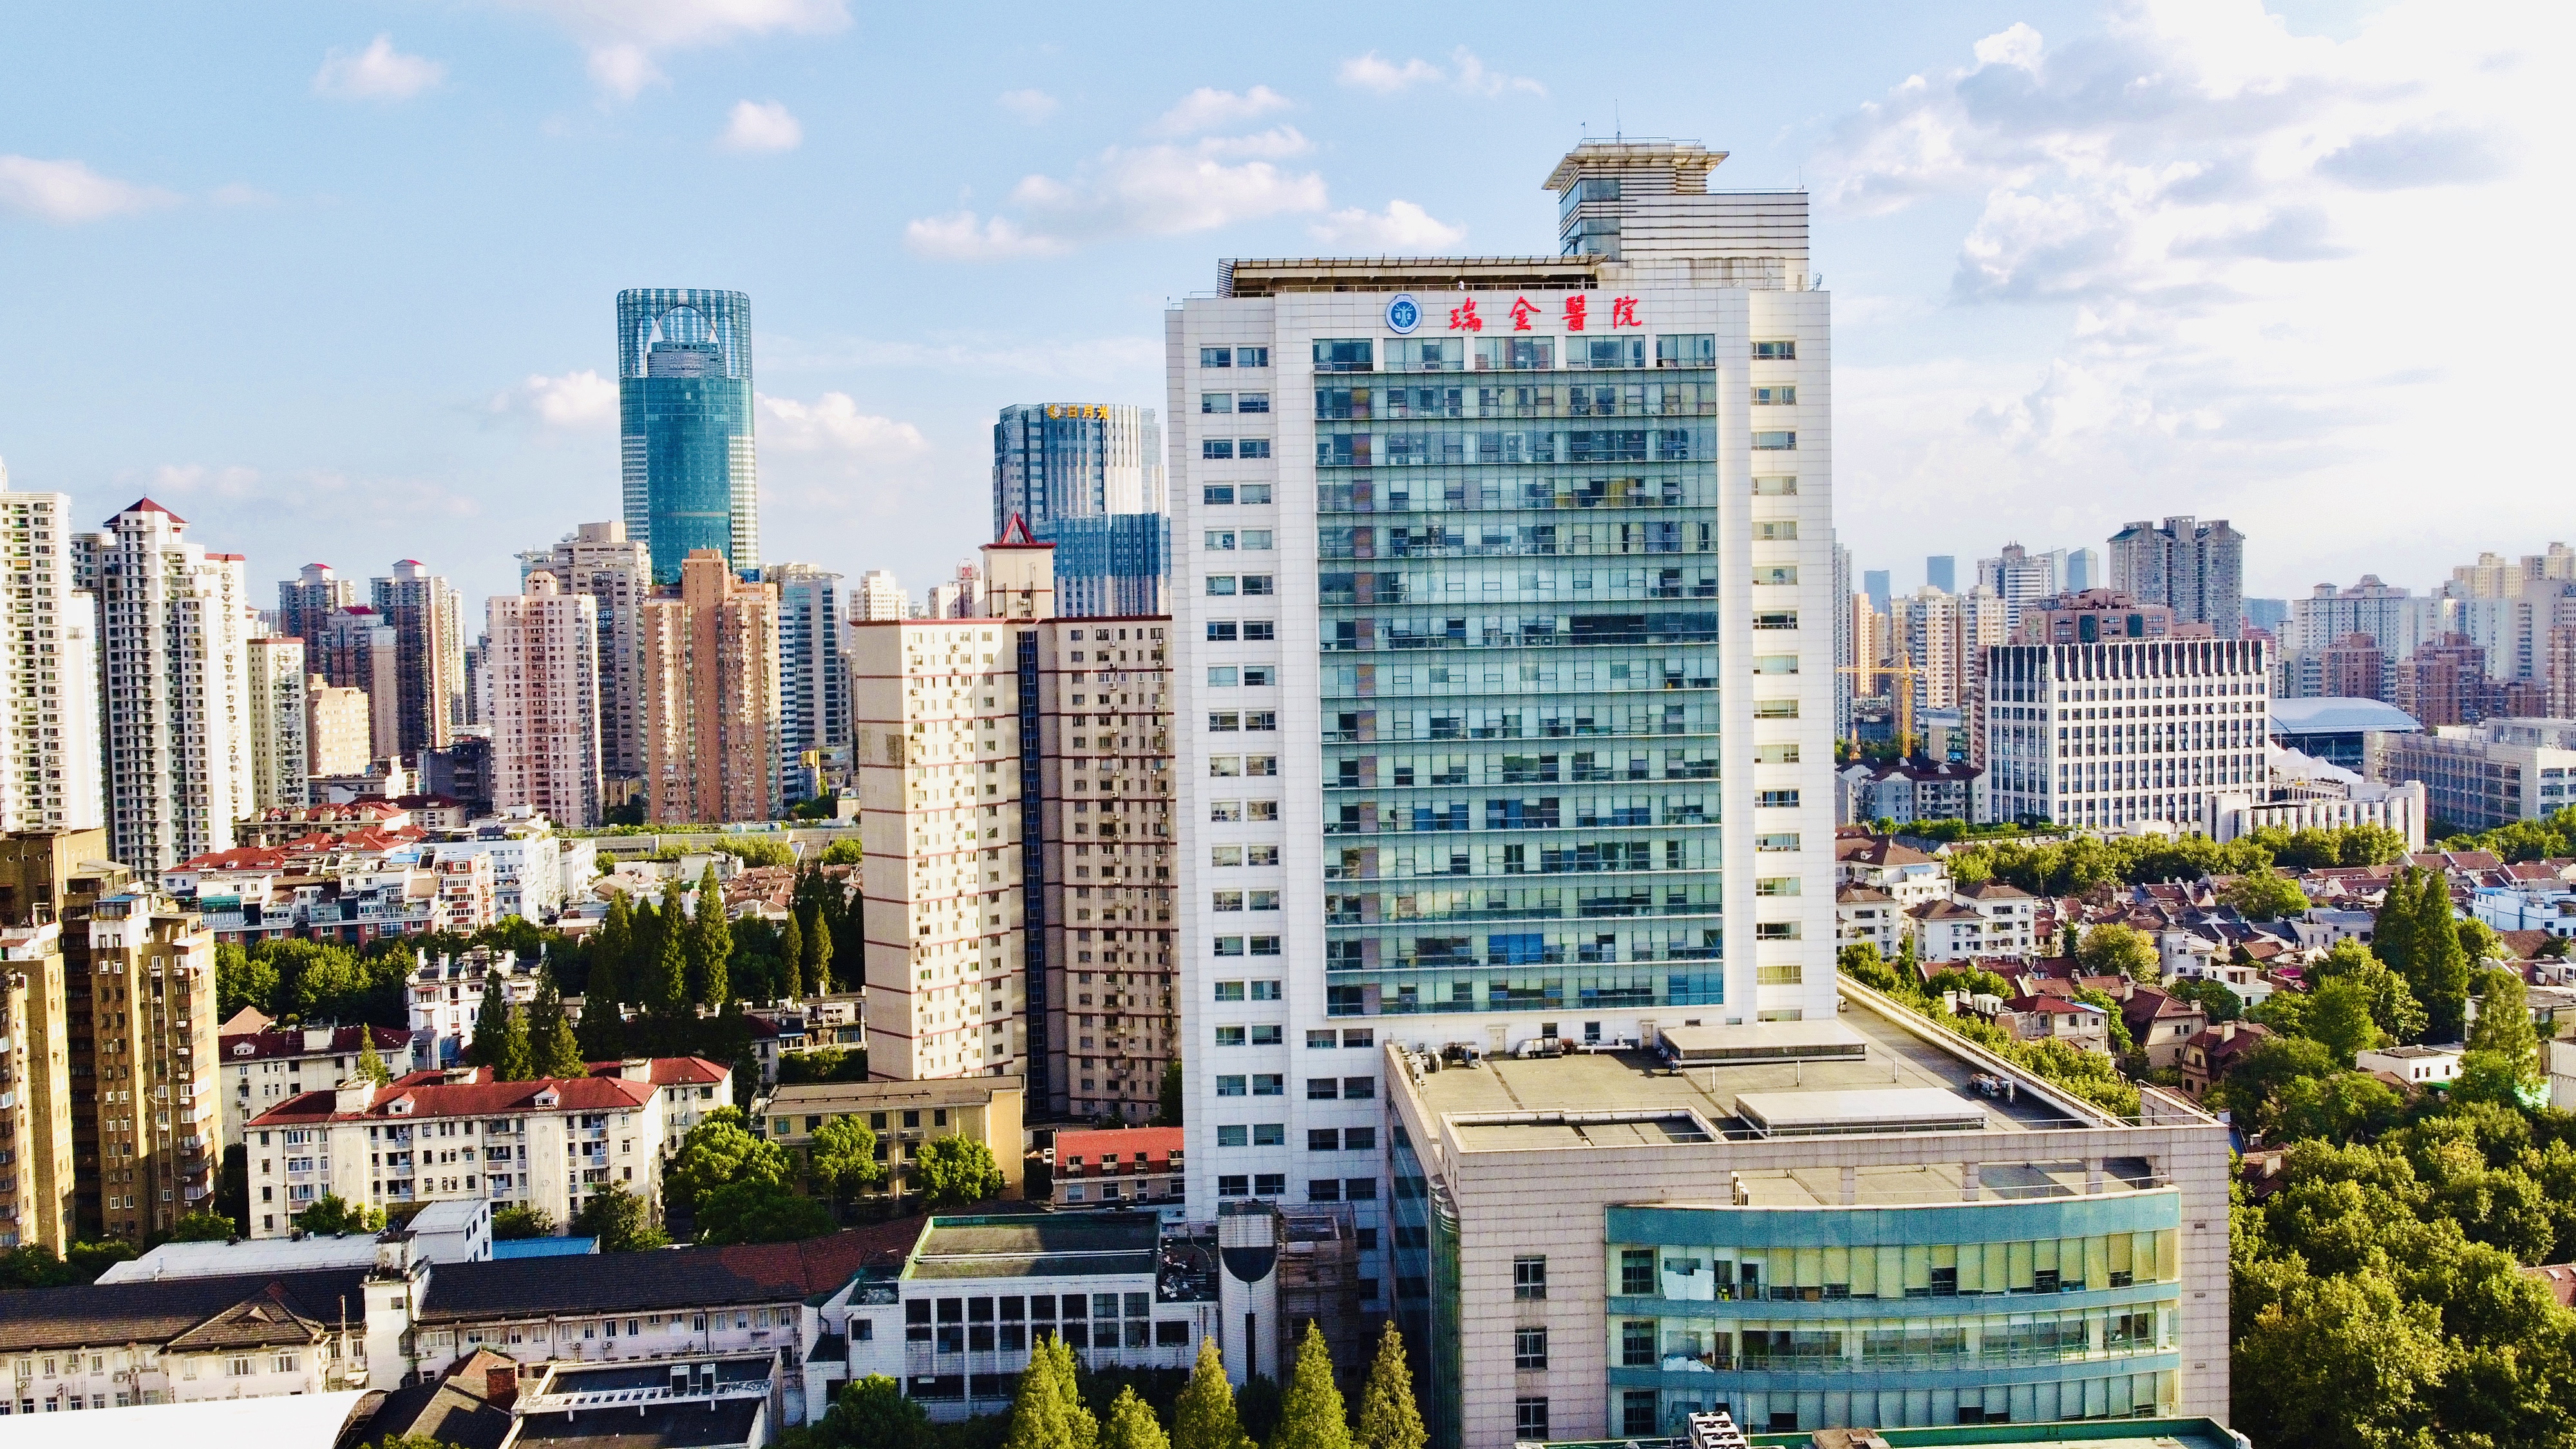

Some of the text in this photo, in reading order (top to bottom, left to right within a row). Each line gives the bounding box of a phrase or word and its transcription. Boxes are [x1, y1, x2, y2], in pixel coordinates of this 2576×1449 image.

[1449, 295, 1642, 331] 瑞金醫院
[1068, 404, 1110, 420] 日月光
